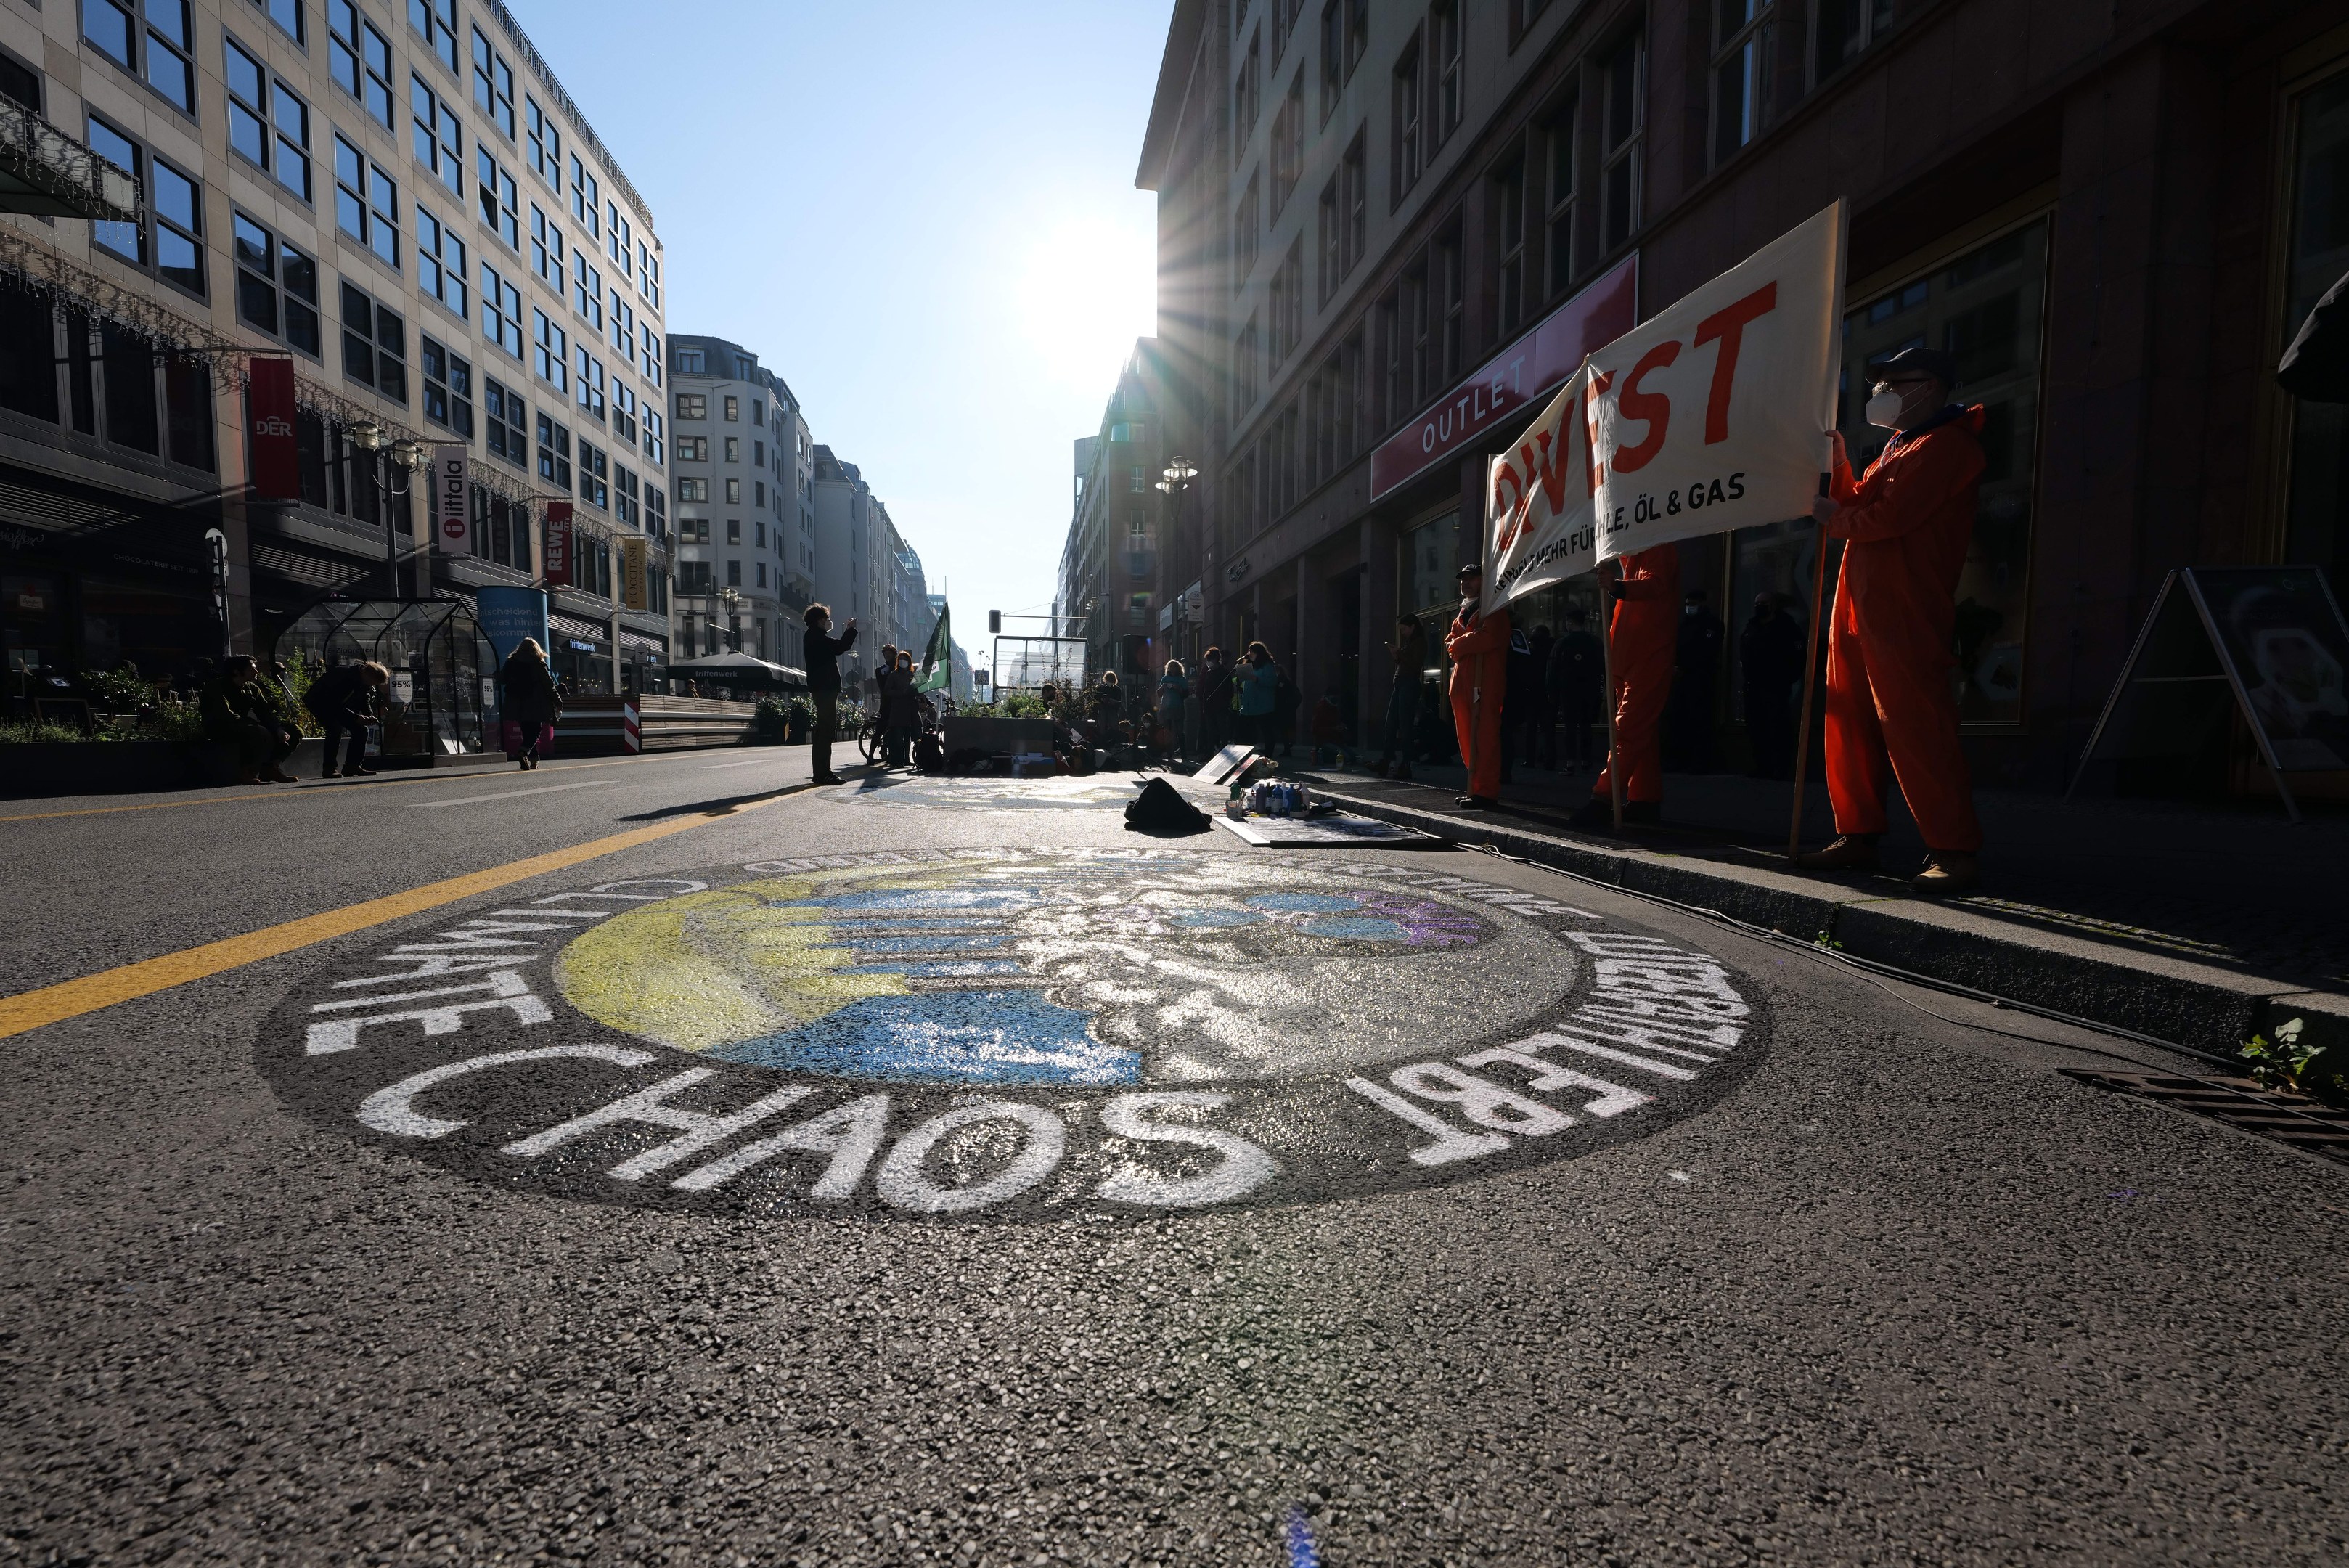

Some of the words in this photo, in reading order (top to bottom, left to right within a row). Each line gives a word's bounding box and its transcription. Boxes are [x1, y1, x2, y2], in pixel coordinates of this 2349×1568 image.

[256, 420, 293, 437] DER
[1423, 354, 1525, 454] OUTLET
[444, 460, 463, 516] iittala
[1635, 493, 1662, 524] ÖL
[1667, 490, 1682, 515] &
[1688, 473, 1745, 510] GAS
[113, 553, 168, 569] CHOCOLATERIE
[547, 520, 564, 571] REWE
[629, 544, 638, 603] L'OCCITANE
[514, 618, 544, 626] hinten
[569, 639, 595, 652] frittenwerk
[306, 878, 709, 1055] CLIMATE
[1558, 930, 1750, 1063] LÜTZERATH
[1347, 1032, 1699, 1166] LEBT
[359, 1044, 1280, 1214] CHAOS
